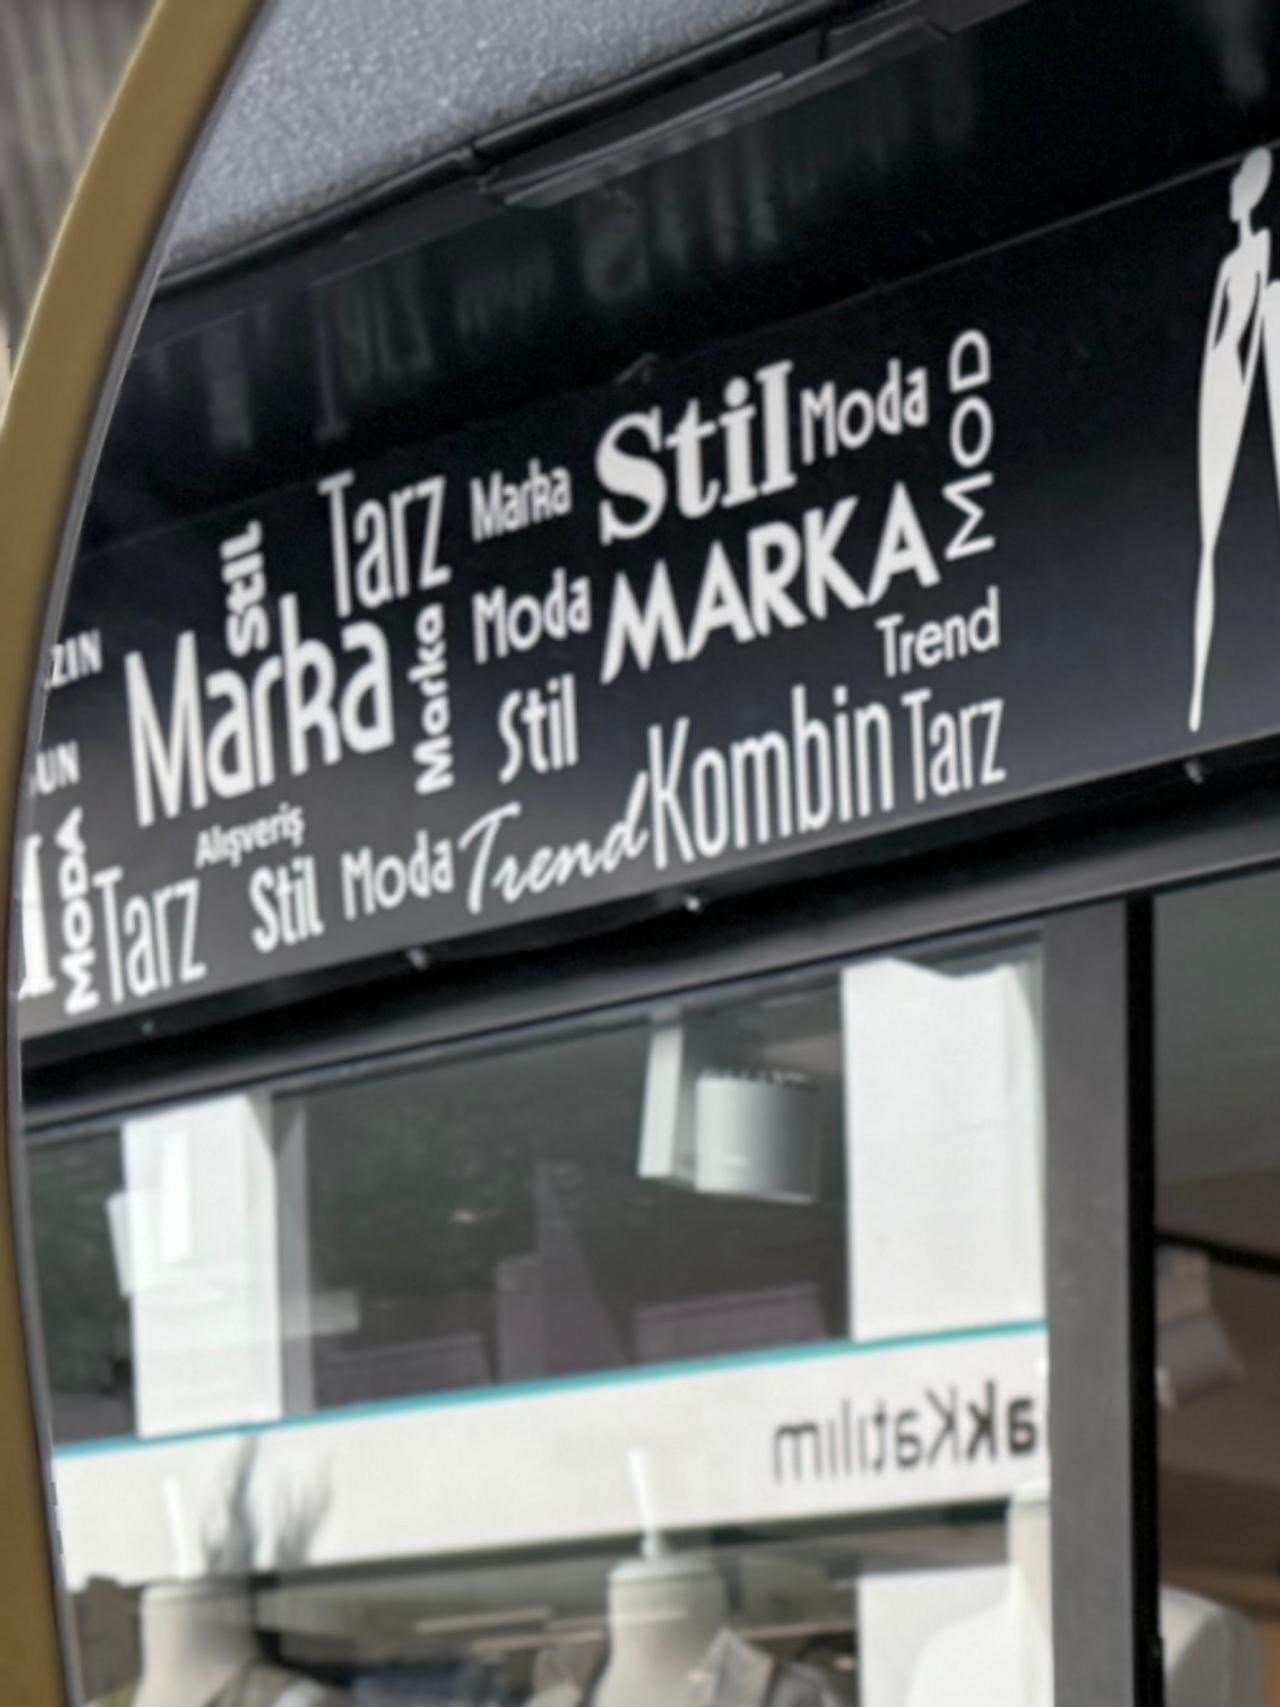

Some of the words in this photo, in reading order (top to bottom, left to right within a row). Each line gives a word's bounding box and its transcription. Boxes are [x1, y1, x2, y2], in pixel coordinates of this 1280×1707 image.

[595, 358, 797, 546] Stil
[801, 358, 928, 466] Moda
[318, 470, 451, 618] Tarz
[470, 459, 571, 542] Marka
[473, 567, 591, 663] Moda
[601, 480, 940, 685] MARKA
[874, 585, 999, 677] Trend
[125, 592, 394, 827] Marka
[408, 604, 453, 795] Marka
[499, 673, 579, 783] Stil
[899, 689, 1006, 801] Tarz
[458, 769, 651, 915] Trend
[648, 684, 894, 870] Kombin
[55, 806, 100, 1015] MODA
[93, 866, 207, 1003] Tarz
[249, 855, 324, 951] Stil
[341, 832, 453, 919] Moda
